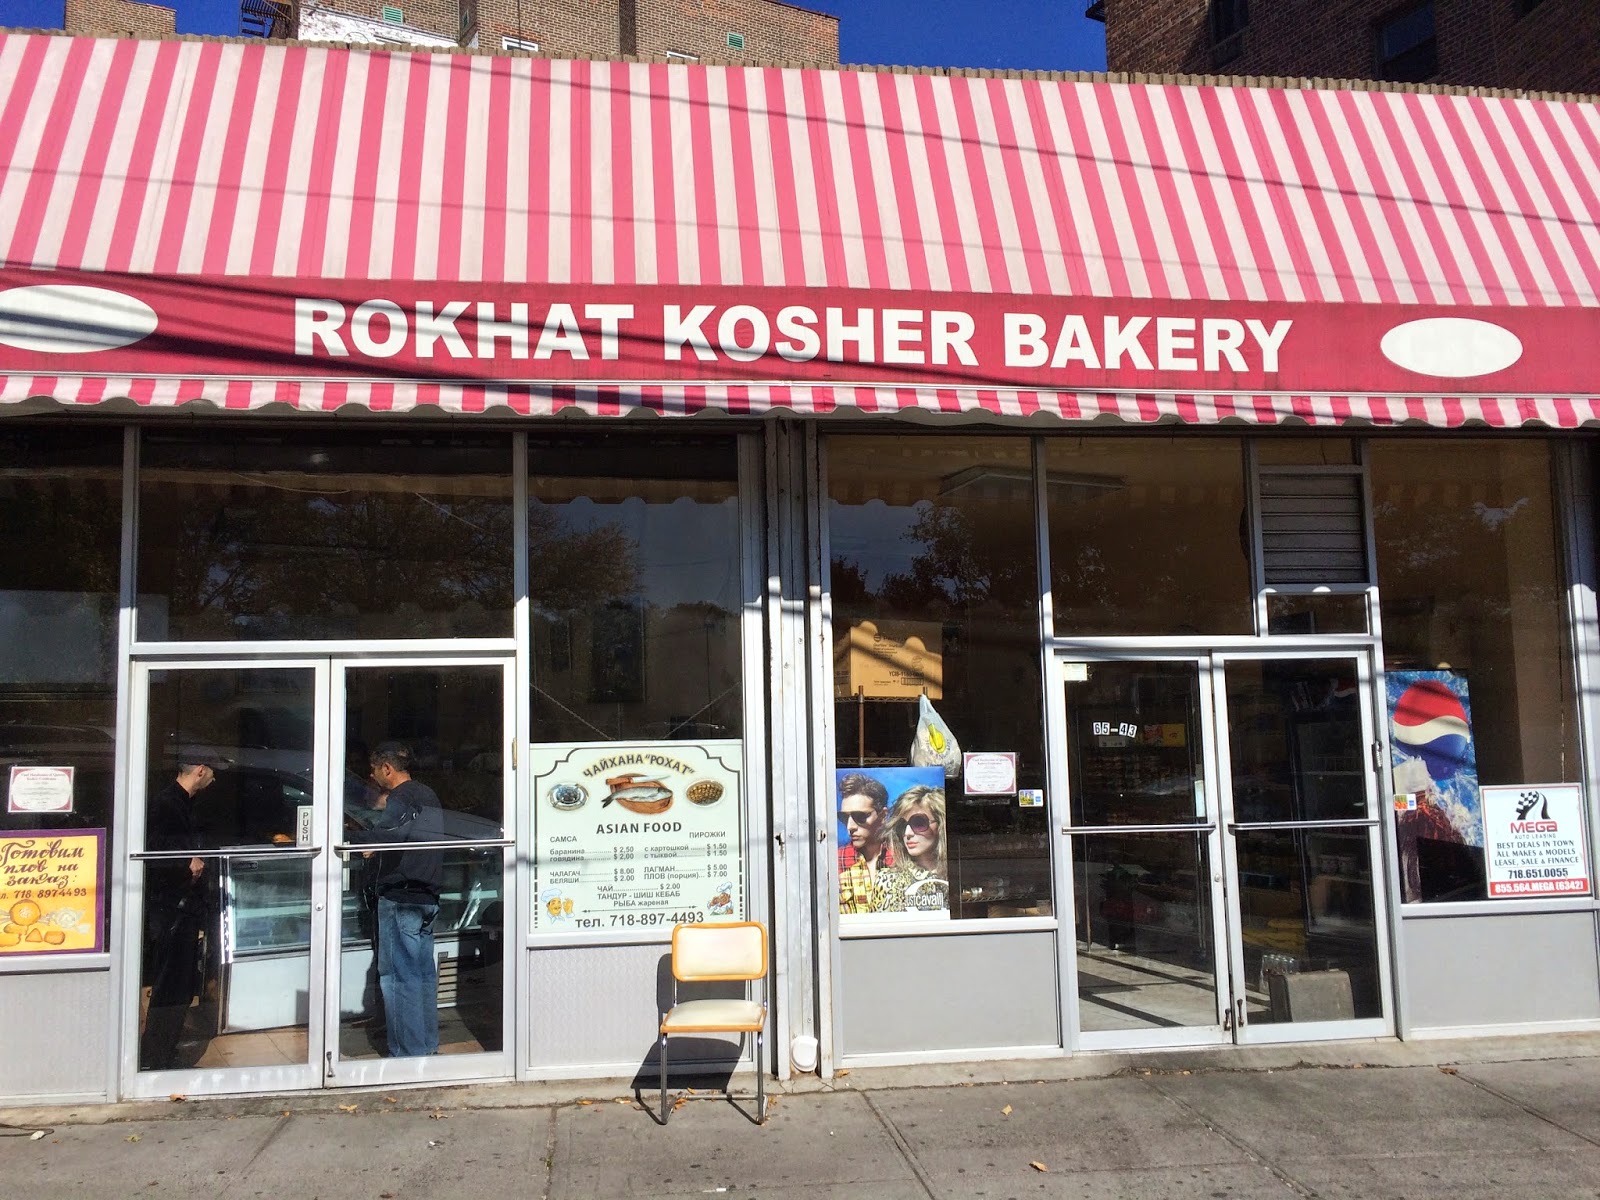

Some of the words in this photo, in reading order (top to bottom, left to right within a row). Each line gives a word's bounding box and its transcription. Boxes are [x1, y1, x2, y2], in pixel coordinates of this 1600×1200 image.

[294, 298, 635, 361] ROKHAT
[662, 304, 979, 367] KOSHER
[1003, 312, 1294, 373] BAKERY
[1094, 722, 1137, 738] 65-43
[583, 754, 643, 777] ЧАЙХАНА
[596, 823, 640, 834] ASIAN
[644, 822, 682, 833] FOOD
[0, 839, 84, 867] Готовим
[4, 859, 48, 874] плов
[57, 864, 78, 872] на
[1508, 868, 1568, 879] 718.651.0055
[37, 888, 87, 898] 8974493
[1495, 881, 1555, 893] 855.564.MEGA
[575, 918, 604, 928] тел.
[610, 911, 704, 926] 718-897-4493
